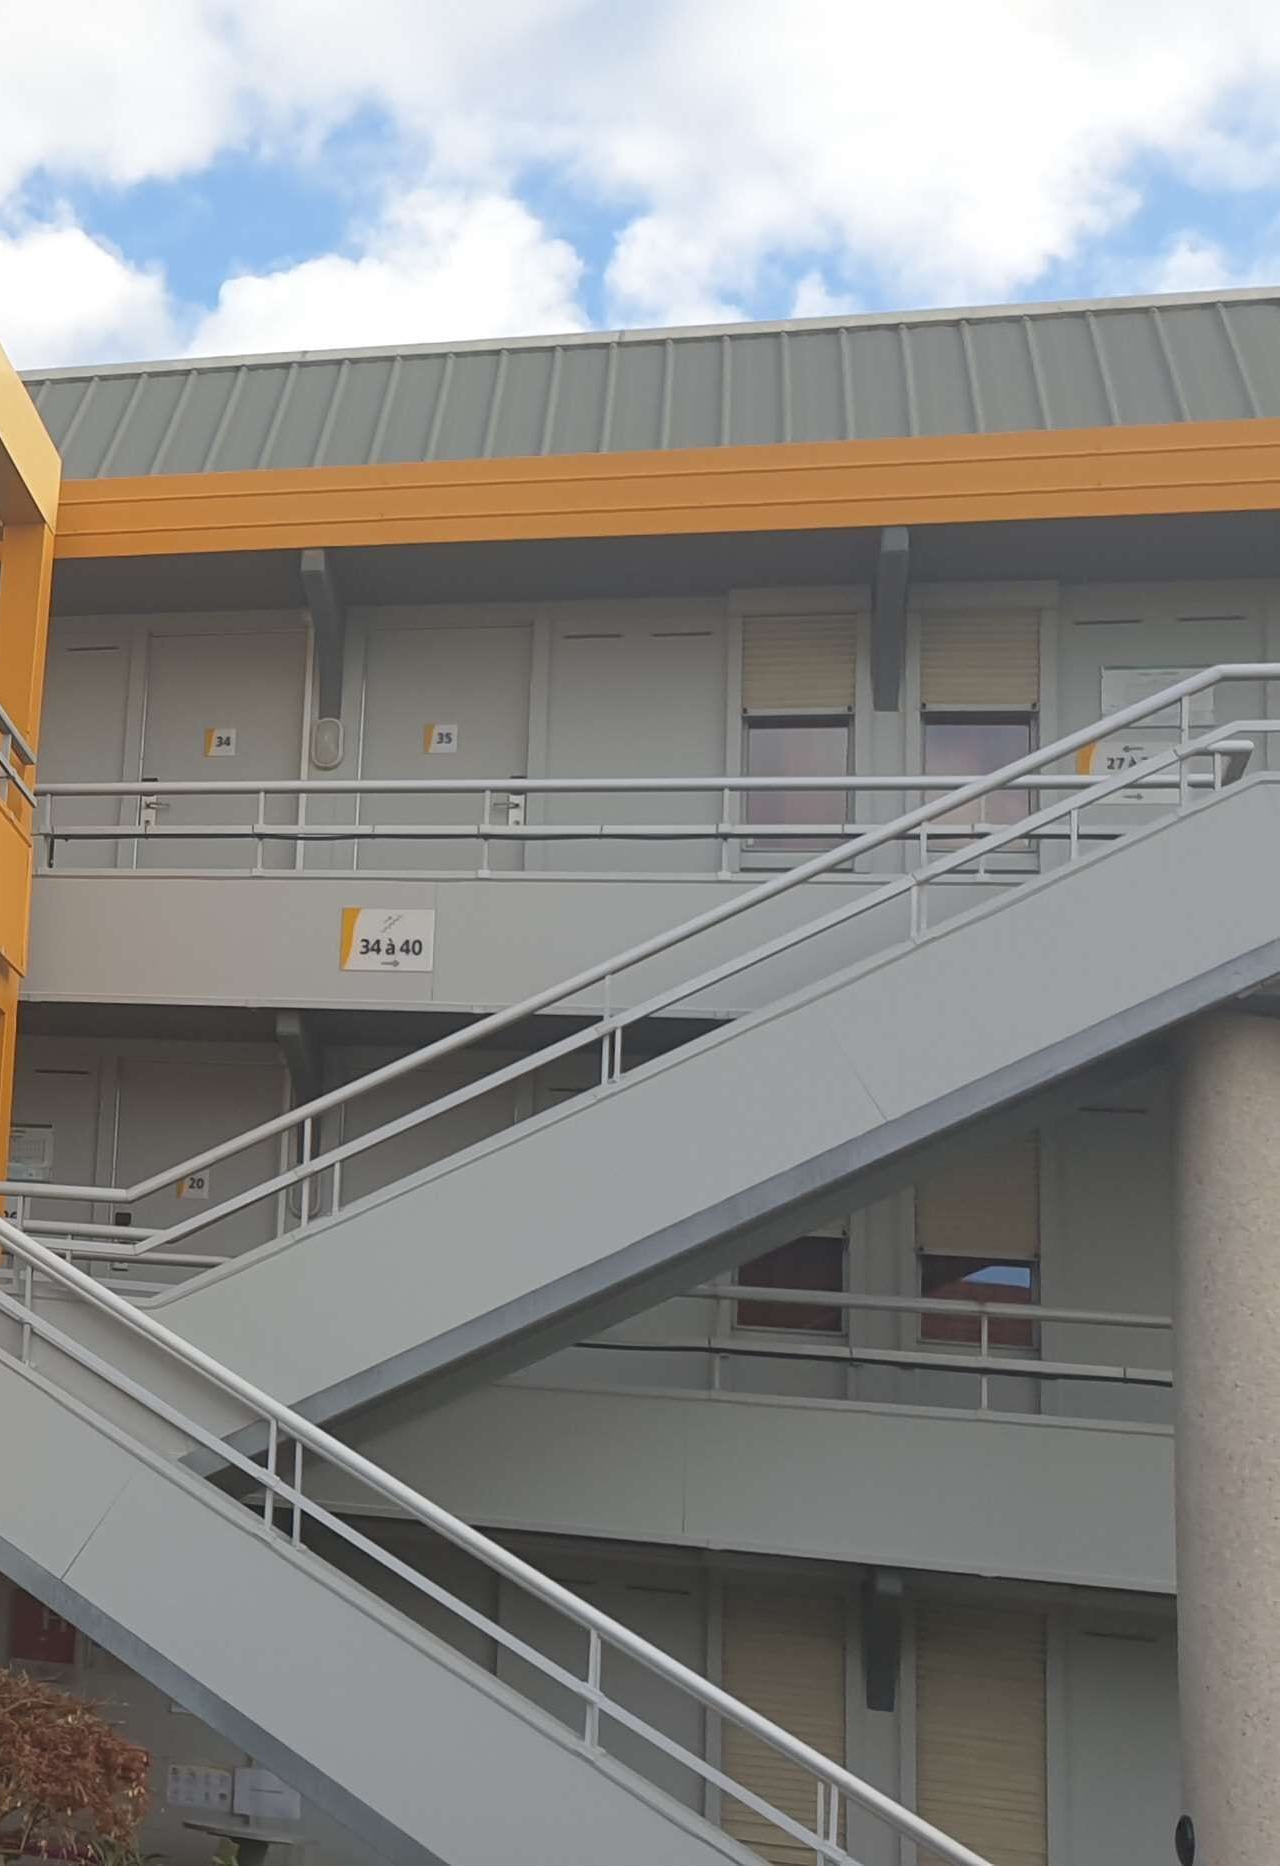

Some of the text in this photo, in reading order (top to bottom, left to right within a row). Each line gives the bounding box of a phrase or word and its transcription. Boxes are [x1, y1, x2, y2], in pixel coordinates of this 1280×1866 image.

[216, 736, 231, 747] 34
[437, 733, 452, 744] 35
[1106, 757, 1125, 770] 27
[359, 937, 423, 956] 34 à 40
[189, 1177, 205, 1189] 20
